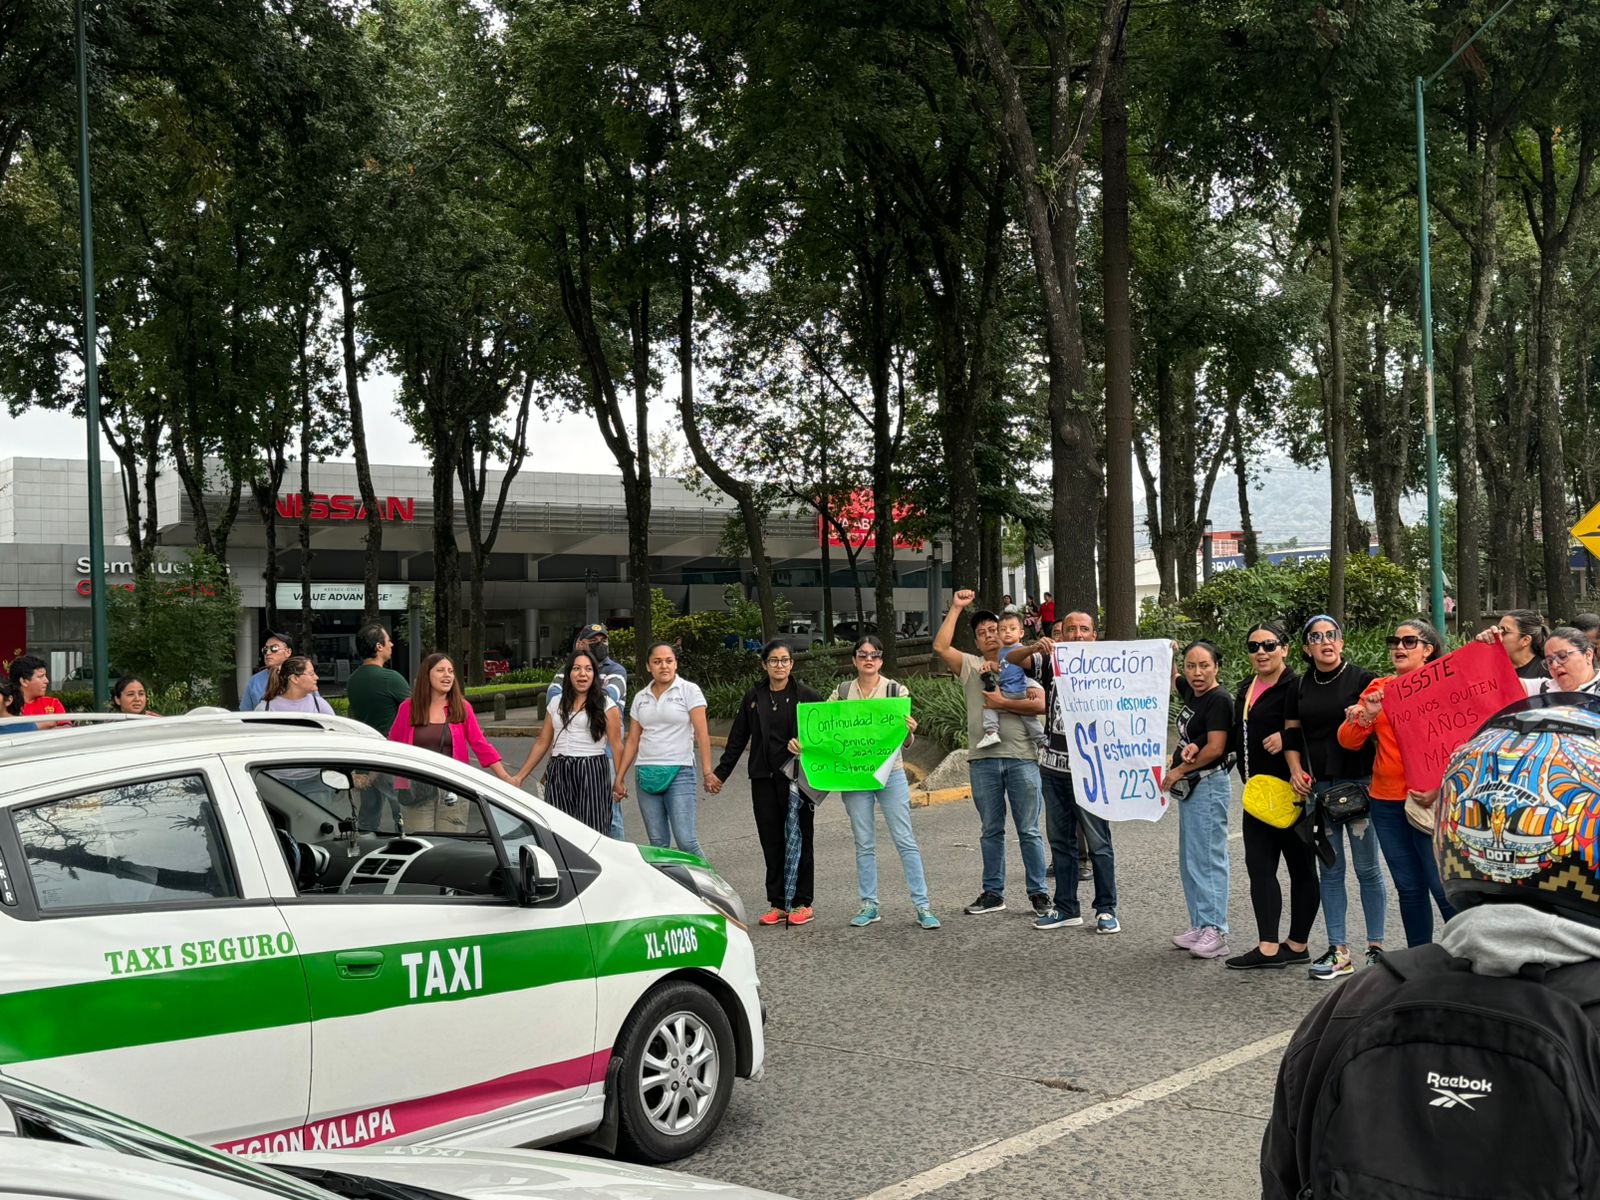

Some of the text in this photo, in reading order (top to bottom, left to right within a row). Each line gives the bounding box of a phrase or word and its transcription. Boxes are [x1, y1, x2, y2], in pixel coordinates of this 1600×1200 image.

[1417, 698, 1440, 717] NOS
[1450, 678, 1498, 705] QUITEN
[807, 708, 895, 746] Continuidad de
[1104, 720, 1115, 737] a
[1131, 713, 1147, 737] la
[1428, 707, 1479, 742] AÑOS
[832, 733, 876, 755] Servicio
[1104, 738, 1160, 761] estancia
[834, 761, 876, 774] Estancia
[1486, 849, 1512, 862] DOT
[104, 931, 295, 975] TAXI SEGURO
[644, 926, 698, 959] XL-10286
[401, 945, 482, 999] TAXI
[1427, 1071, 1492, 1092] Reebok
[310, 1109, 396, 1151] XALAPA
